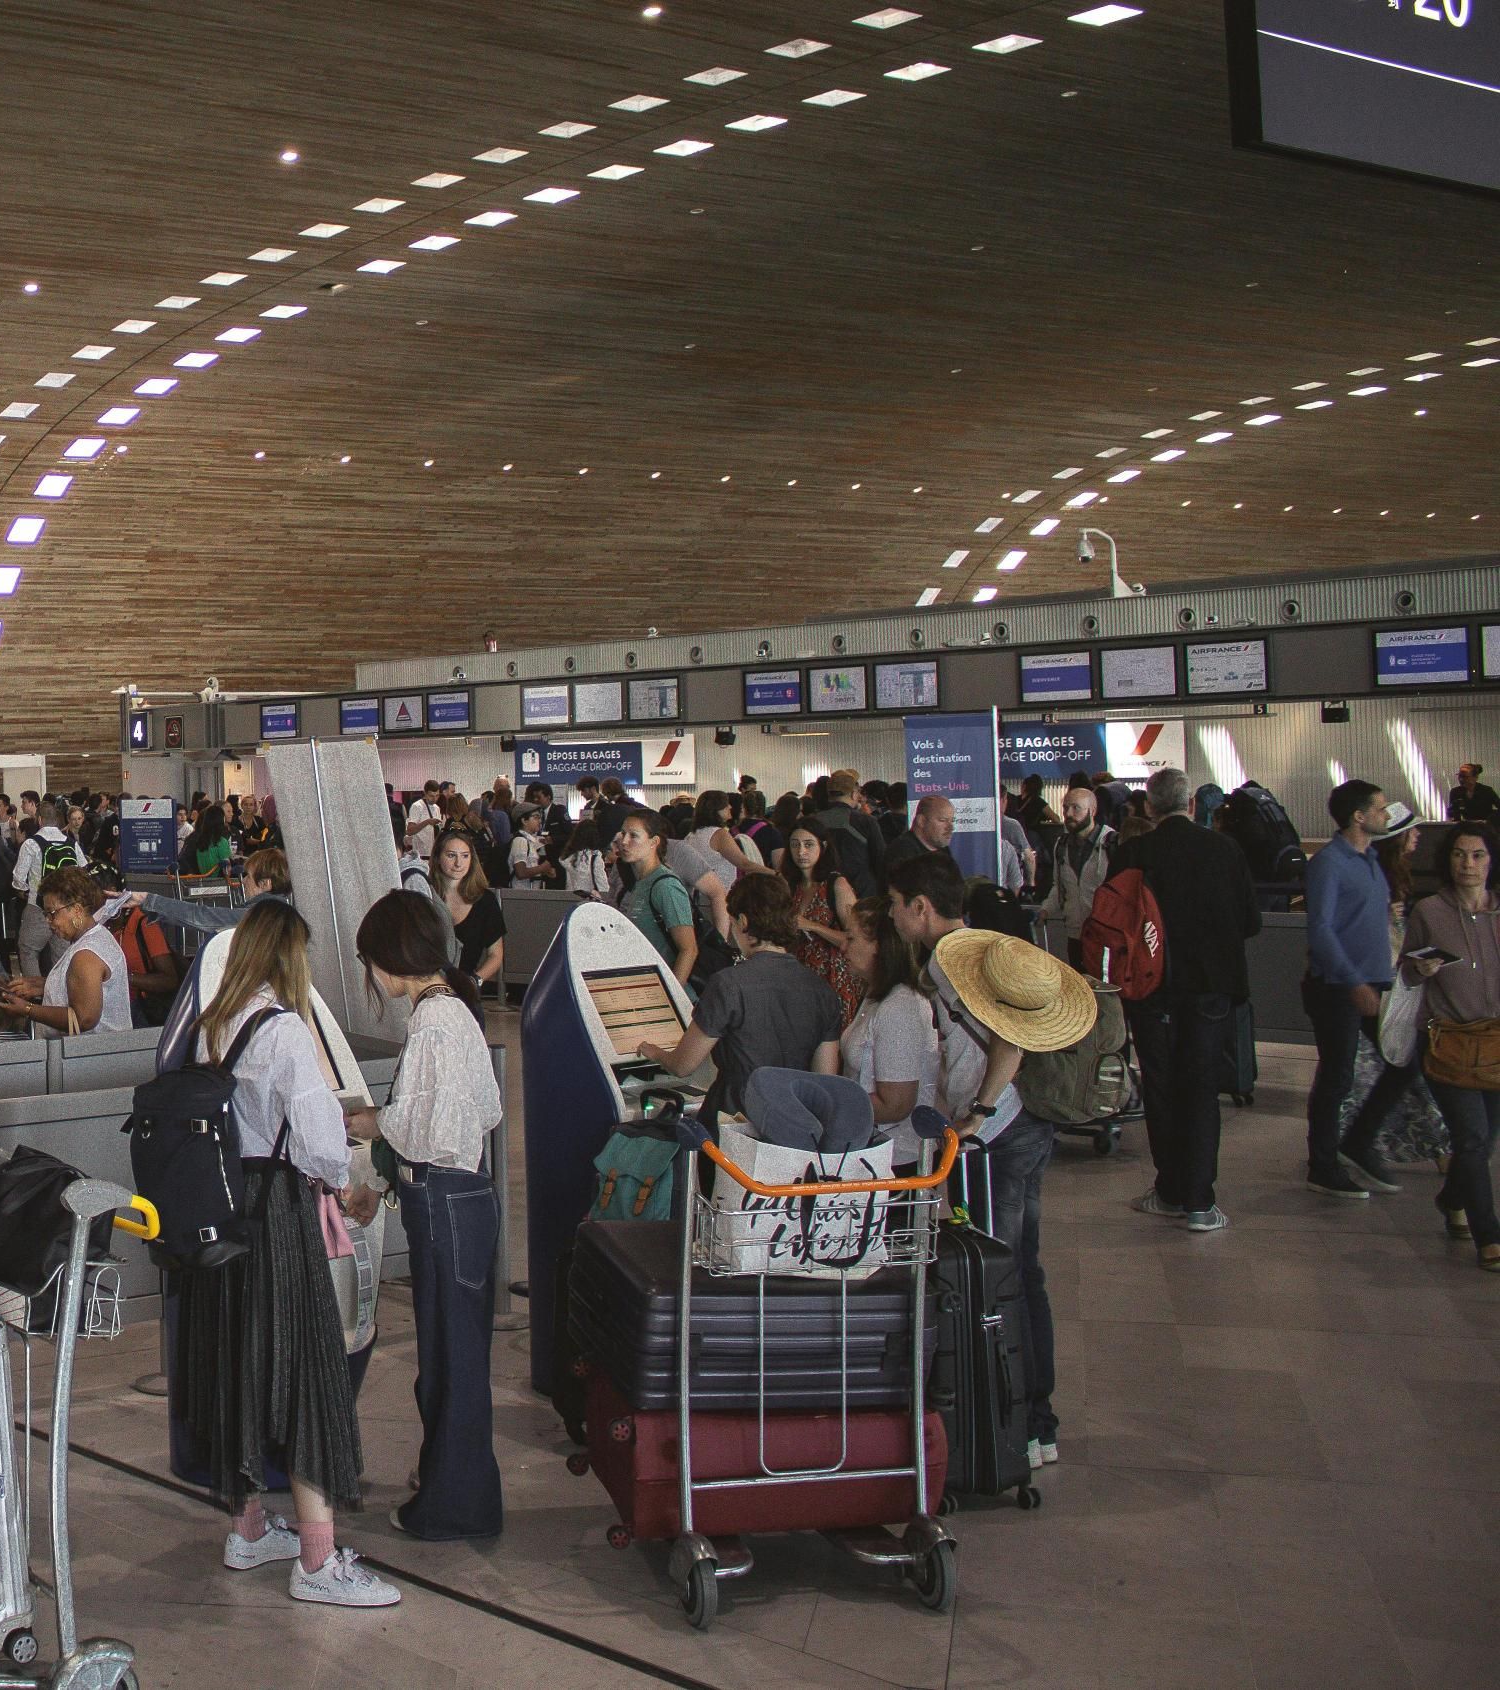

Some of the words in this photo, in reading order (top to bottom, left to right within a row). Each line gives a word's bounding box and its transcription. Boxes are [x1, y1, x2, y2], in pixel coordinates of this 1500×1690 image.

[1191, 646, 1242, 655] AIRFRANCE
[1257, 706, 1263, 714] 5
[133, 720, 143, 741] 4
[912, 740, 934, 750] Vols
[937, 739, 943, 749] à
[1016, 736, 1075, 748] BAGAGES
[547, 750, 578, 761] DÉPOSE
[580, 750, 621, 760] BAGAGES
[913, 752, 971, 764] destination
[1029, 750, 1092, 761] DROP-OFF
[547, 762, 587, 772] BAGGAGE
[589, 761, 632, 772] DROP-OFF
[913, 769, 931, 778] des
[915, 781, 970, 793] Etats-Unis
